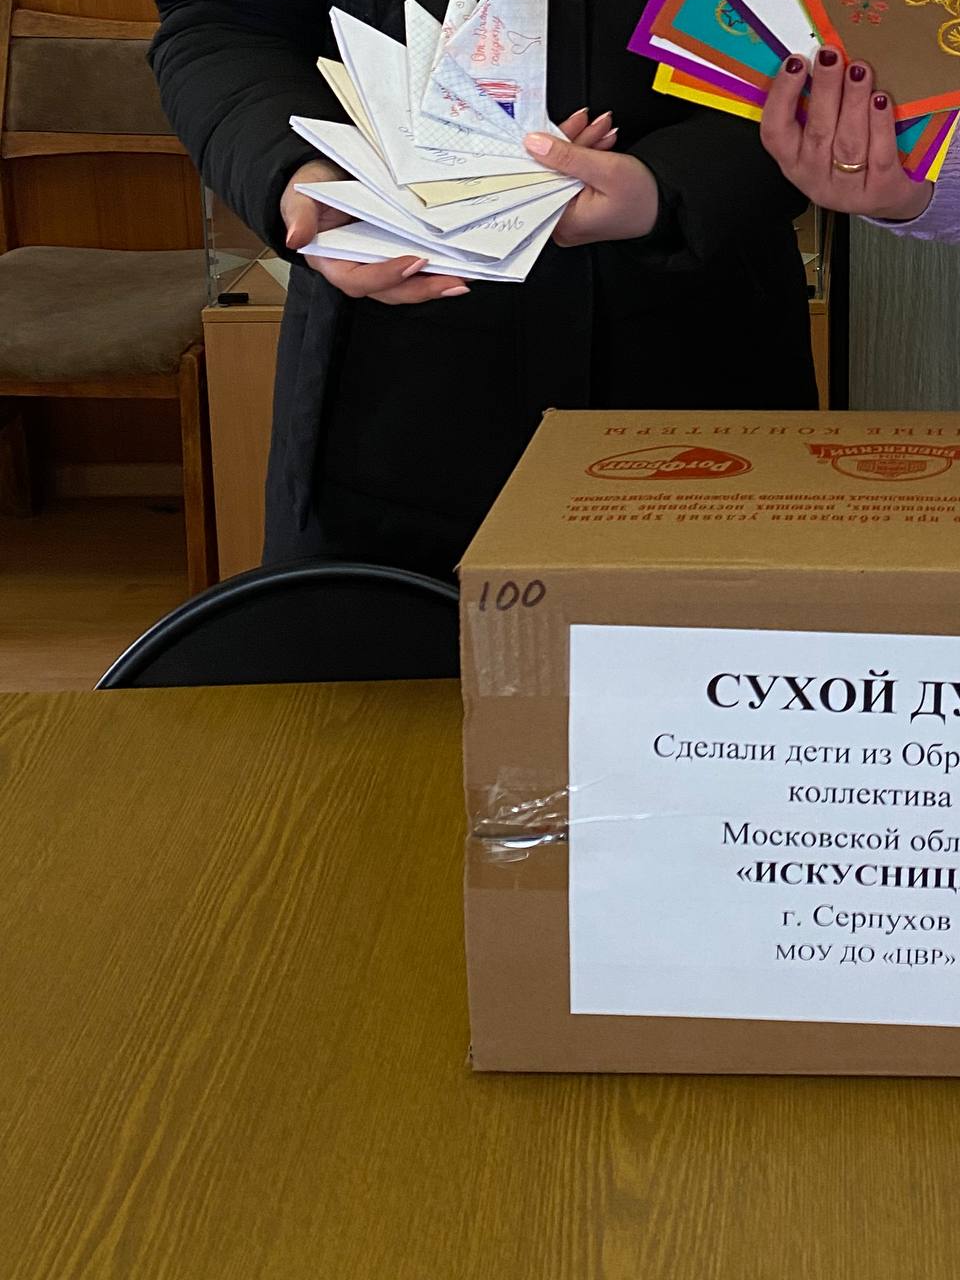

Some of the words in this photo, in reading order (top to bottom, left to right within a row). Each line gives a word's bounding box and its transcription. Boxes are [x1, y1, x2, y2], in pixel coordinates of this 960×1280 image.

[605, 426, 840, 435] КОНДИТЕРЫ
[479, 580, 546, 611] 100
[707, 670, 896, 713] СУХОЙ
[654, 734, 775, 760] Сделали
[786, 746, 850, 764] дети
[863, 749, 891, 765] из
[789, 786, 952, 807] коллектива
[724, 822, 899, 850] Московской
[783, 912, 801, 926] г.
[813, 906, 950, 935] Серпухов
[777, 945, 832, 960] МОУ
[840, 946, 874, 964] ДО
[883, 949, 955, 967] «ЦВР»
